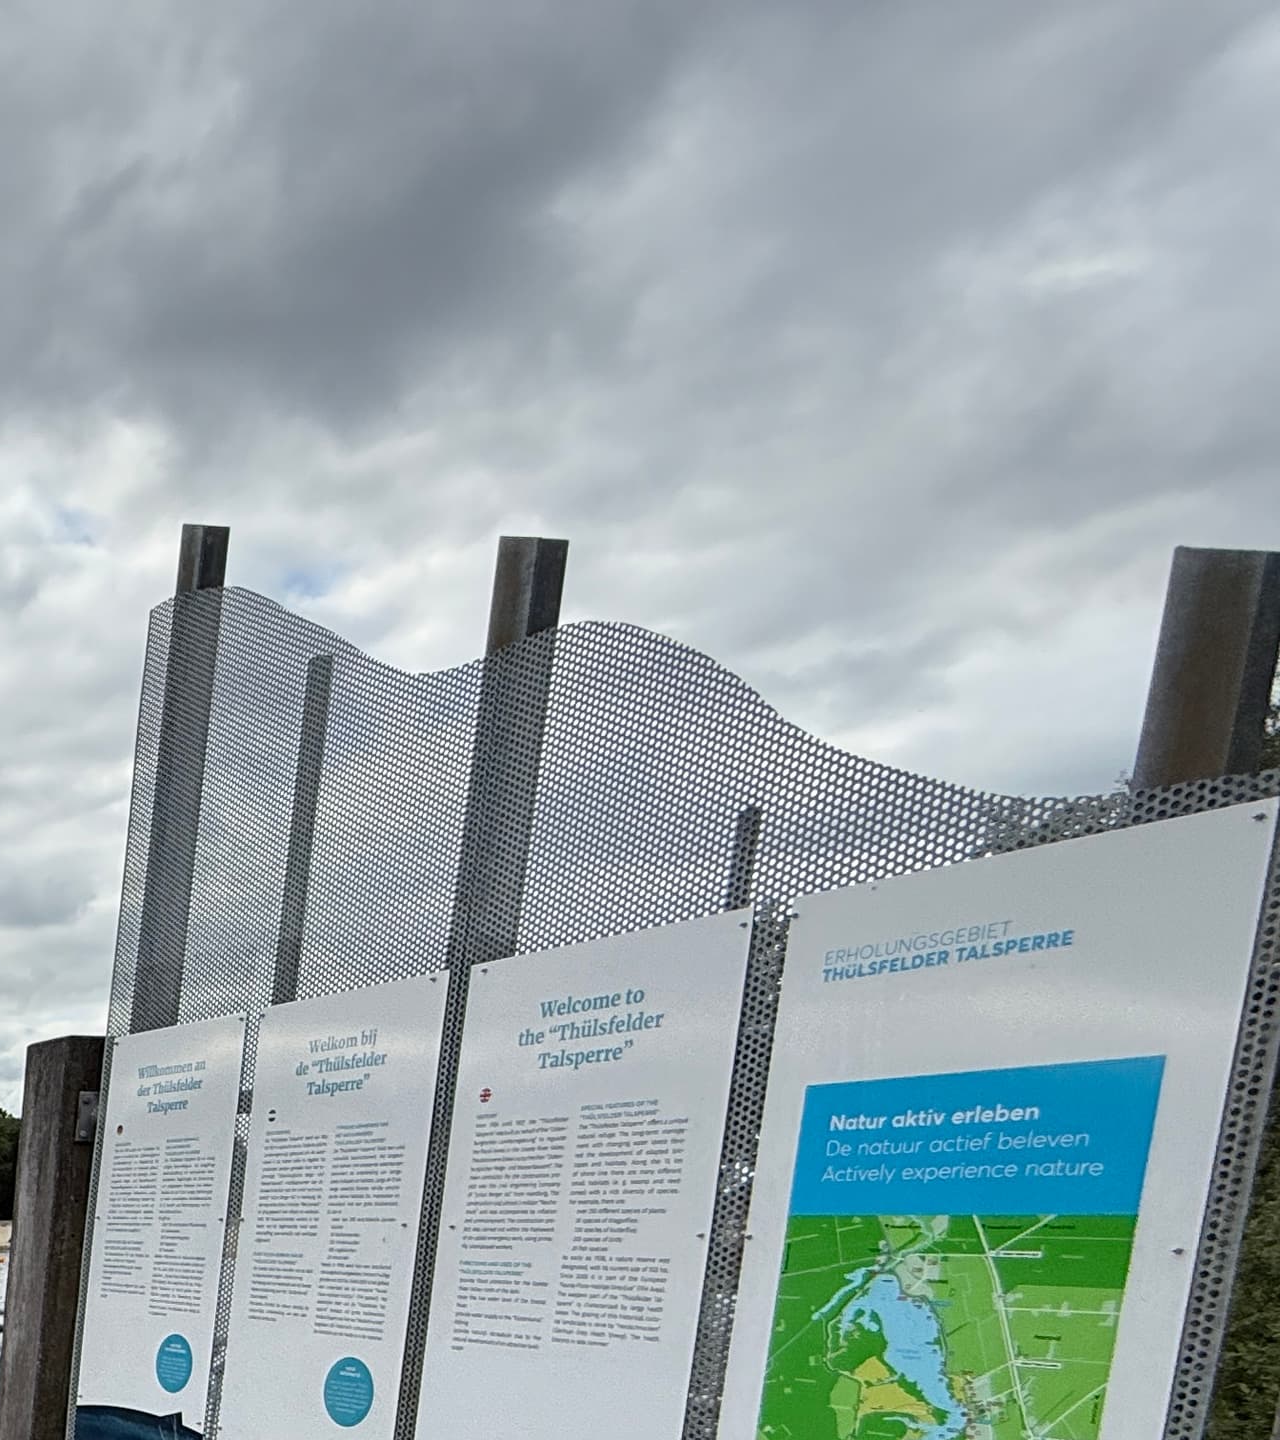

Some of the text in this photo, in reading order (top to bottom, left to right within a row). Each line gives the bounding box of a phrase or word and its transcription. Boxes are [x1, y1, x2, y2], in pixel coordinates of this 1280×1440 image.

[822, 929, 1075, 983] THÜLSFELDER TALSPERRE
[824, 920, 1014, 967] ERHOLUNGSGEBIET
[541, 988, 645, 1018] Welcome to
[308, 1028, 378, 1053] Welkom bij
[518, 1028, 545, 1046] the
[138, 1060, 206, 1079] Willkommen an
[295, 1061, 310, 1076] de
[137, 1076, 203, 1097] der Thülsfelder
[147, 1099, 189, 1115] Talsperre
[829, 1103, 1040, 1132] Natur aktiv erleben
[825, 1131, 1090, 1157] De natuur actief beleven
[821, 1159, 1105, 1185] Actively experience nature
